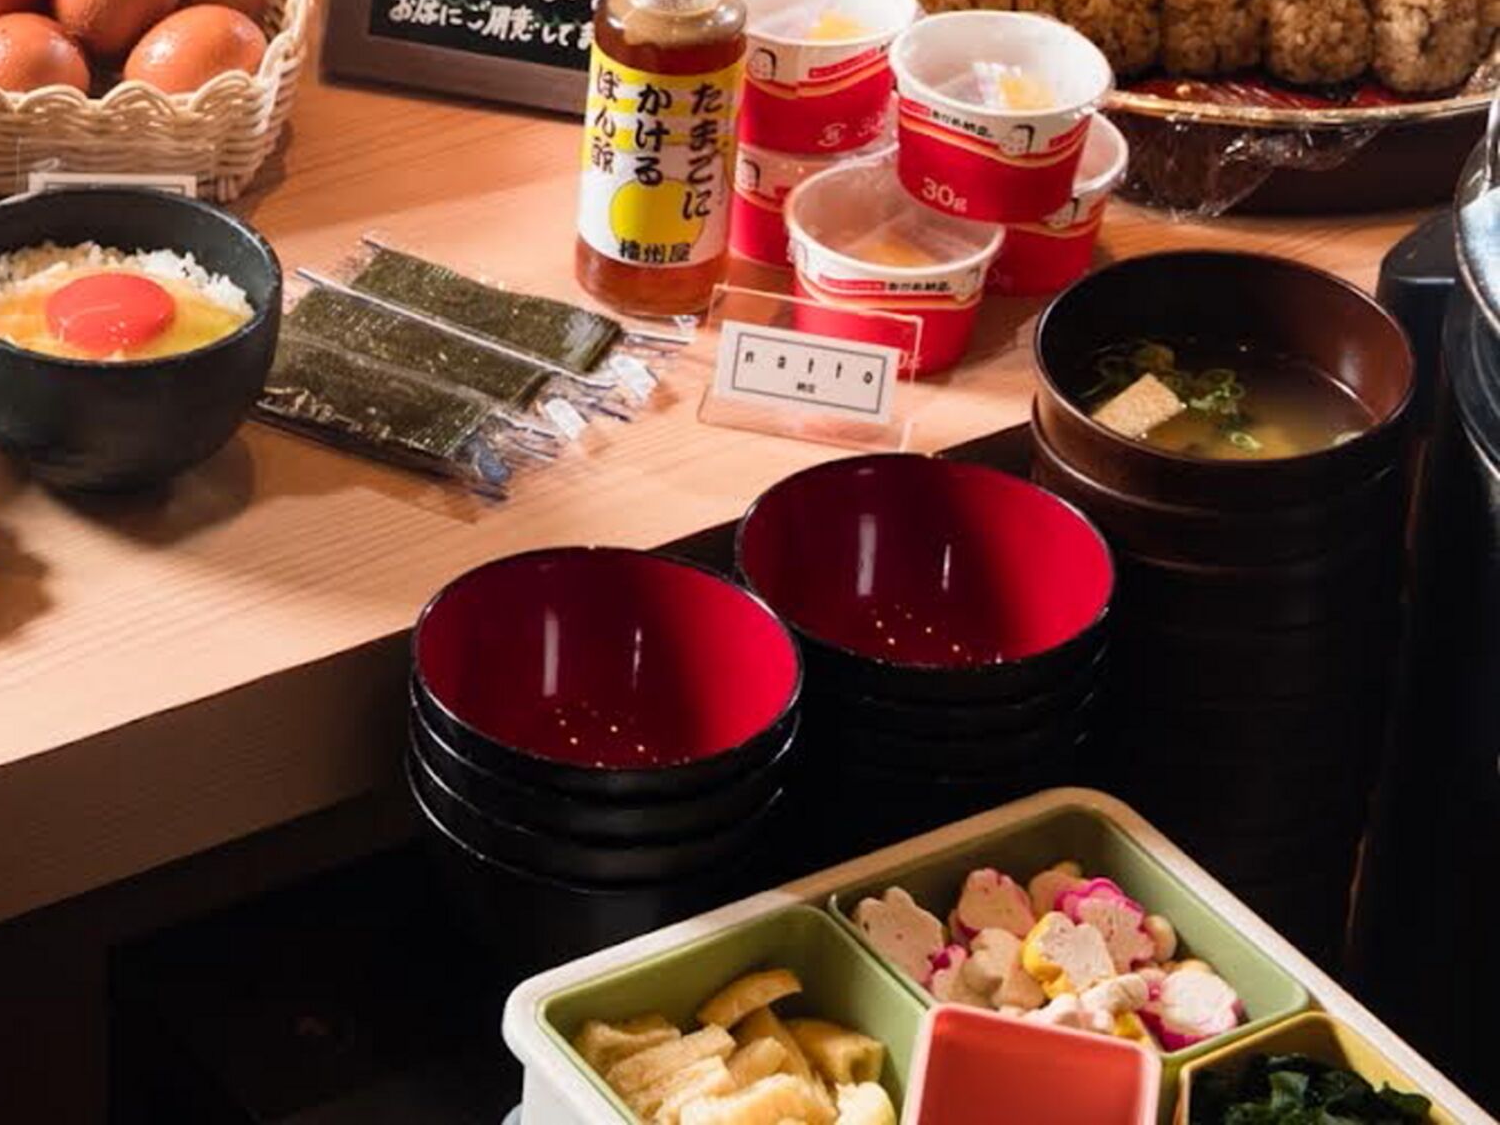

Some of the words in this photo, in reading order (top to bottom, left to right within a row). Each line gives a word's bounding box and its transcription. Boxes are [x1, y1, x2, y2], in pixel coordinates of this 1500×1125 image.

[634, 82, 673, 186] かける
[682, 82, 723, 221] たまごに
[921, 176, 968, 213] 30g
[745, 351, 873, 383] natto
